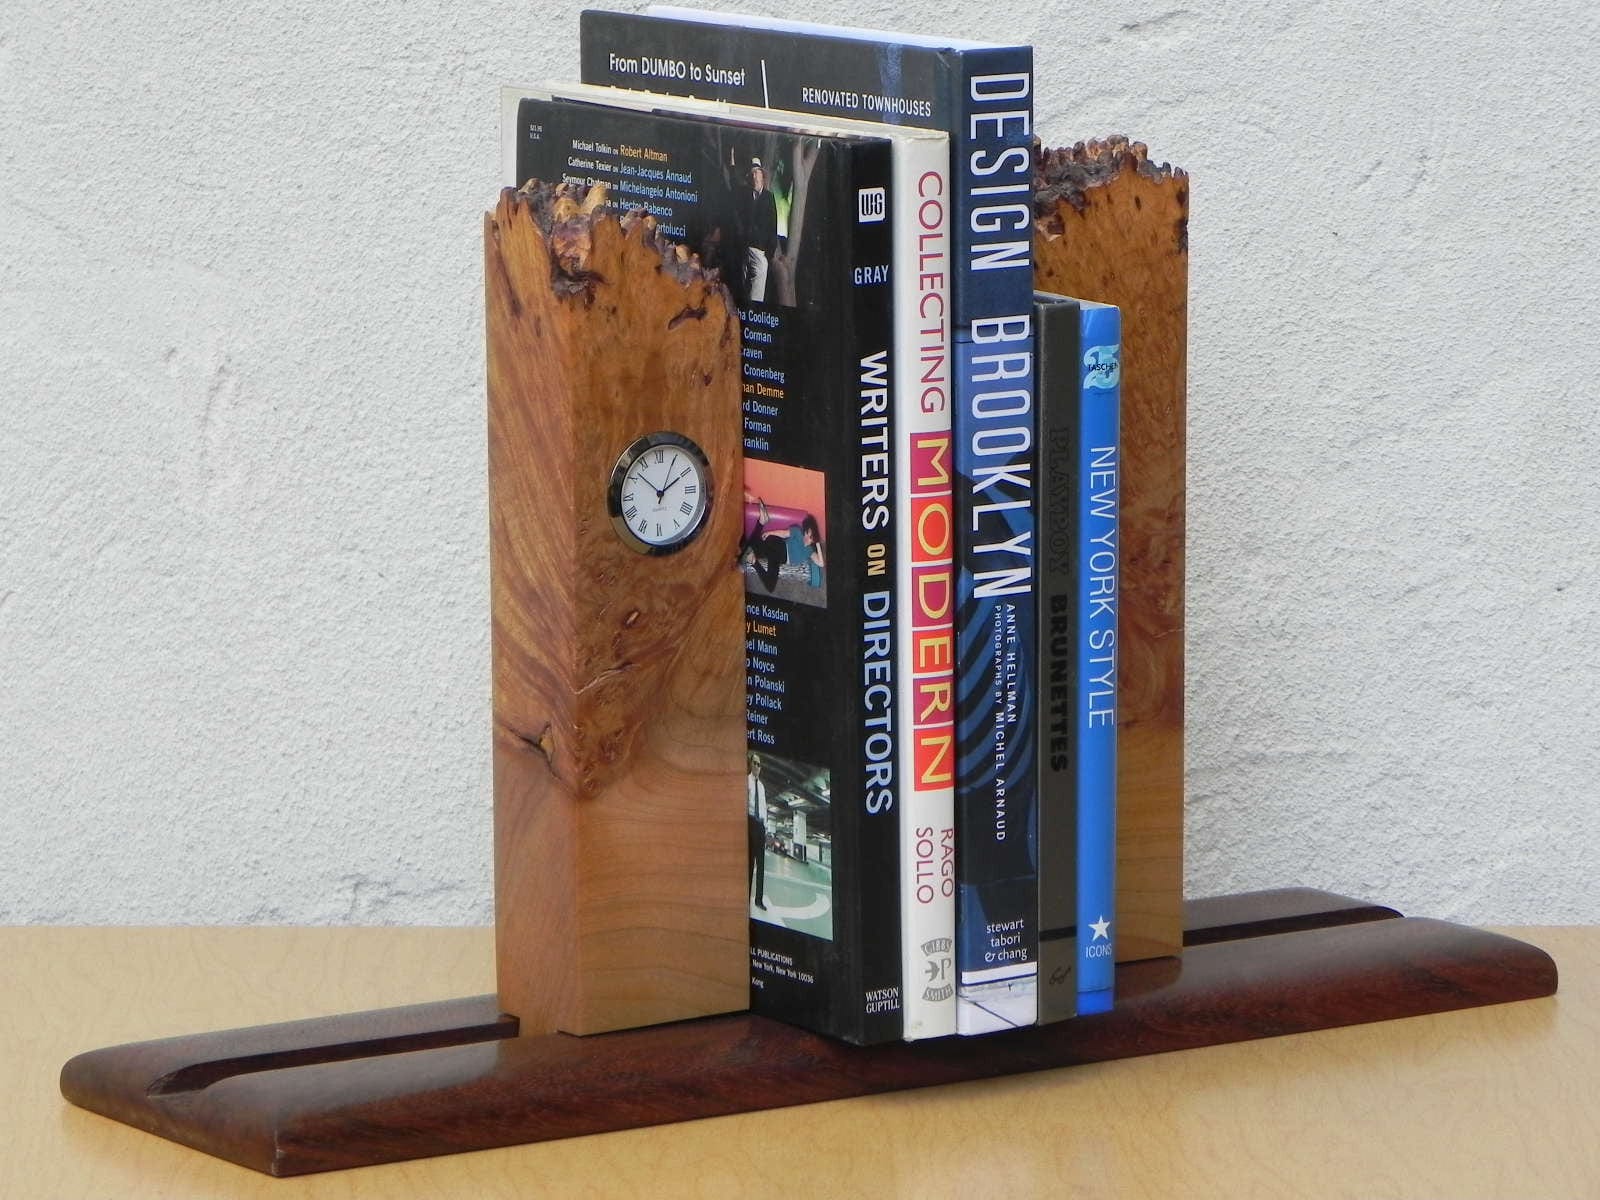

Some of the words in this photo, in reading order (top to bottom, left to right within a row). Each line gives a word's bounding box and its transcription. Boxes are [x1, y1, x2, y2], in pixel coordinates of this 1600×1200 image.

[608, 53, 638, 73] From
[641, 57, 686, 79] DUMBO
[690, 62, 702, 81] to
[705, 64, 746, 86] Sunset
[802, 87, 858, 110] RENOVATED
[862, 94, 931, 117] TOWNHOUSES
[572, 139, 594, 152] Michael
[595, 142, 612, 155] Tolkin
[620, 144, 642, 159] Robert
[644, 149, 668, 162] Altman
[567, 156, 594, 170] Catherine
[619, 162, 664, 181] Jean-Jacques
[665, 169, 692, 184] Annaud
[970, 72, 1030, 270] DESIGN
[562, 173, 586, 186] Seymour
[619, 181, 664, 198] Michelangelo
[665, 186, 698, 203] Antonioni
[644, 202, 673, 217] Babenco
[656, 219, 686, 237] ertolucci
[854, 265, 889, 285] GRAY
[917, 171, 945, 413] COLLECTING
[748, 310, 779, 328] Coolidge
[744, 327, 772, 343] Corman
[743, 347, 763, 360] raven
[744, 363, 785, 384] Cronenberg
[757, 383, 785, 399] Demme
[752, 400, 779, 416] Donner
[744, 417, 772, 433] Forman
[744, 437, 769, 451] ranklin
[860, 350, 890, 530] WRITERS
[971, 314, 1032, 599] BROOKLYN
[1090, 446, 1116, 519] NEW
[866, 543, 886, 577] ON
[1089, 531, 1116, 619] YORK
[762, 604, 789, 623] Kasdan
[916, 438, 953, 784] MODERN
[753, 621, 777, 637] Lumet
[1006, 604, 1016, 644] ANNE
[757, 639, 778, 656] Mann
[994, 605, 1003, 689] PHOTOGRAPHS
[753, 657, 775, 673] Noyce
[755, 675, 785, 693] Polanski
[1006, 652, 1017, 723] HELLMAN
[1050, 594, 1068, 772] BRUNETTES
[1088, 629, 1115, 729] STYLE
[756, 693, 782, 710] Pollack
[863, 590, 894, 815] DIRECTORS
[995, 691, 1003, 705] BY
[758, 729, 775, 745] Ross
[995, 712, 1006, 771] MICHEL
[996, 778, 1007, 841] ARNAUD
[916, 827, 934, 904] SOLLO
[940, 827, 954, 898] RAGO
[986, 918, 1024, 934] stewart
[990, 932, 1021, 947] tabori
[757, 948, 793, 966] PUBLICATIONS
[984, 952, 995, 962] &
[997, 947, 1028, 963] chang
[1085, 944, 1112, 958] ICONS
[752, 959, 763, 969] New
[775, 966, 786, 976] New
[787, 969, 797, 979] York
[865, 987, 899, 1002] WATSON
[866, 1000, 900, 1014] GUPTILL
